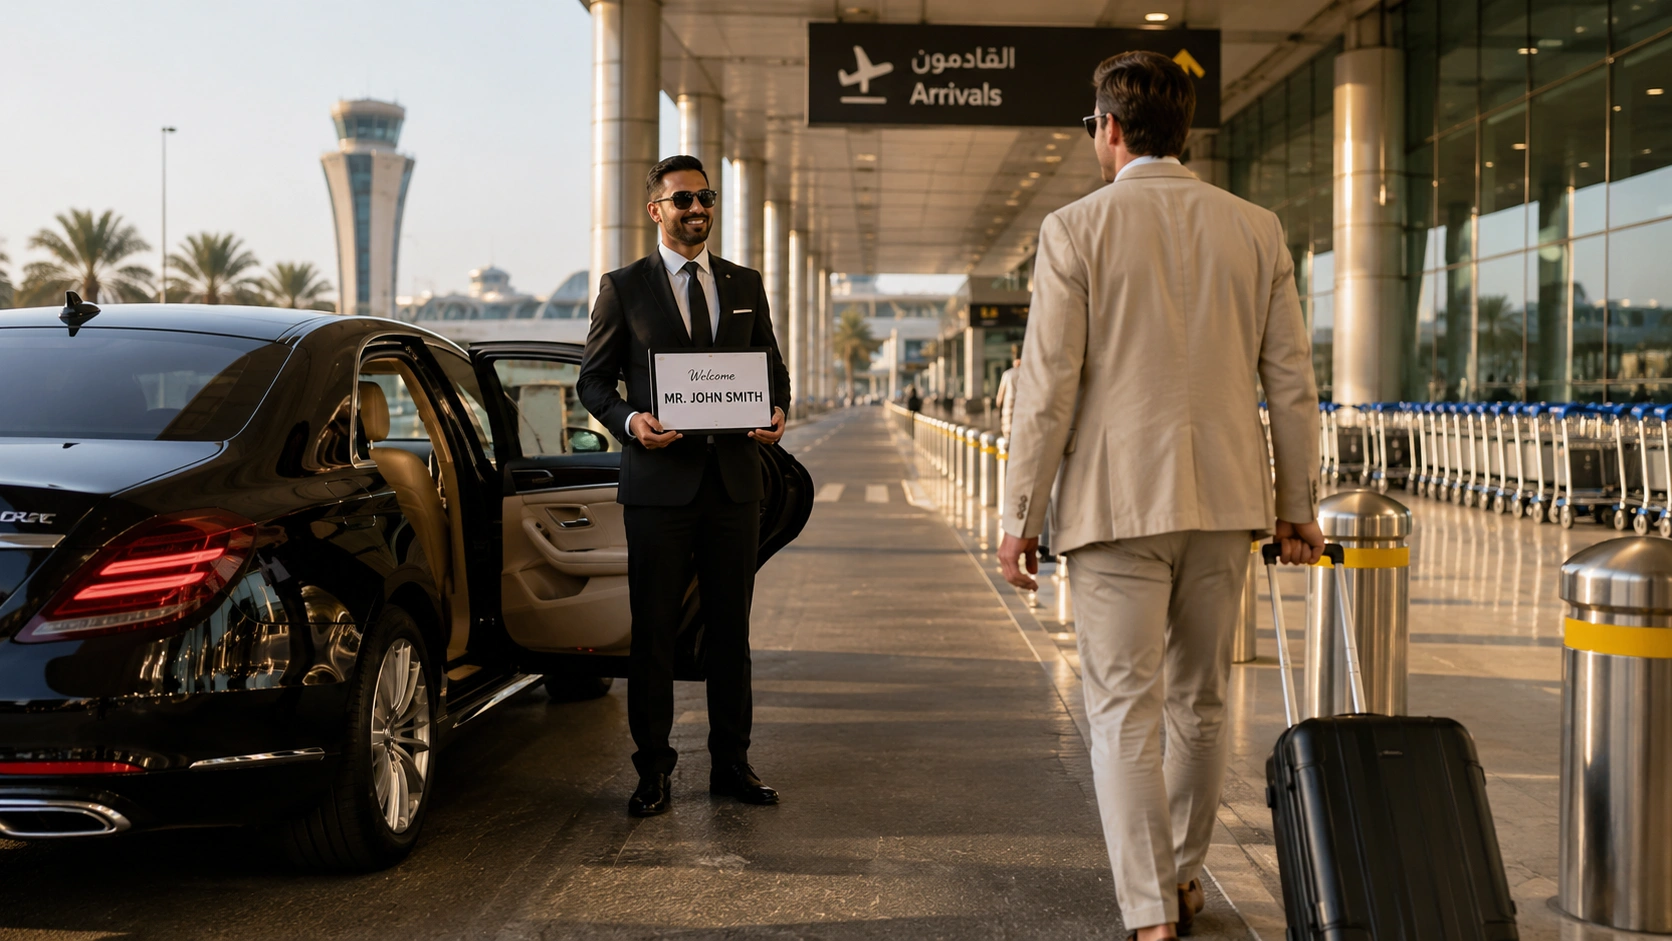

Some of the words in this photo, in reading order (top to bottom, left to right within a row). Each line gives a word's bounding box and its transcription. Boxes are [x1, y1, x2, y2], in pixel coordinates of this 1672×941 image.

[912, 47, 1015, 74] القادمون
[910, 82, 1002, 106] Arrivals
[687, 369, 736, 382] Welcome
[664, 393, 687, 404] MR.
[690, 392, 722, 403] JOHN
[725, 391, 763, 403] SMITH
